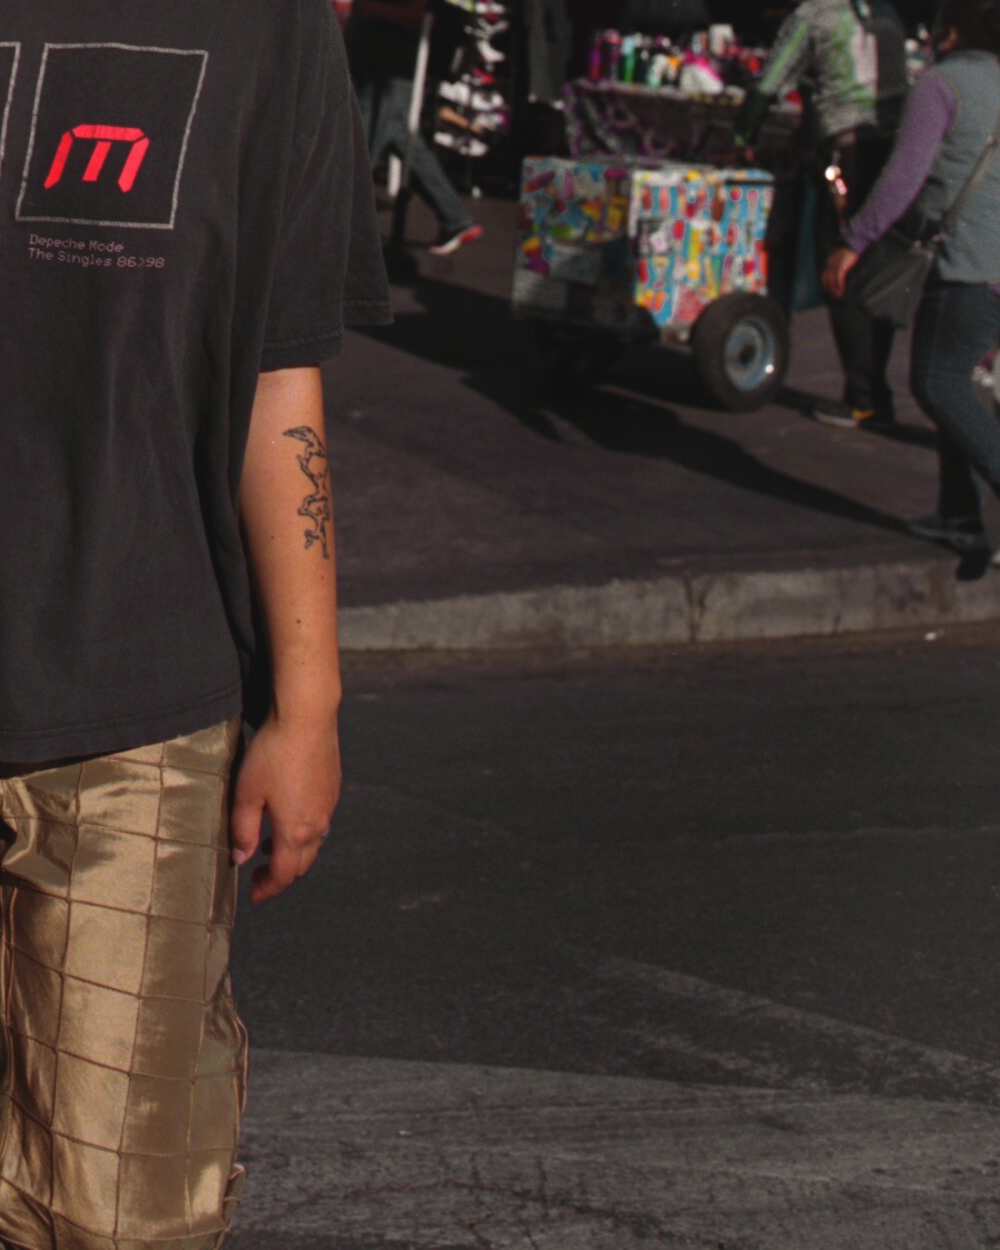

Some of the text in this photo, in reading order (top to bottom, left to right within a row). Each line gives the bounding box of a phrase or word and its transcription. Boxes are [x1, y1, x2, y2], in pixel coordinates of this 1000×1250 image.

[28, 234, 124, 253] Depeche Mode
[28, 248, 54, 261] The
[57, 251, 113, 268] Singles
